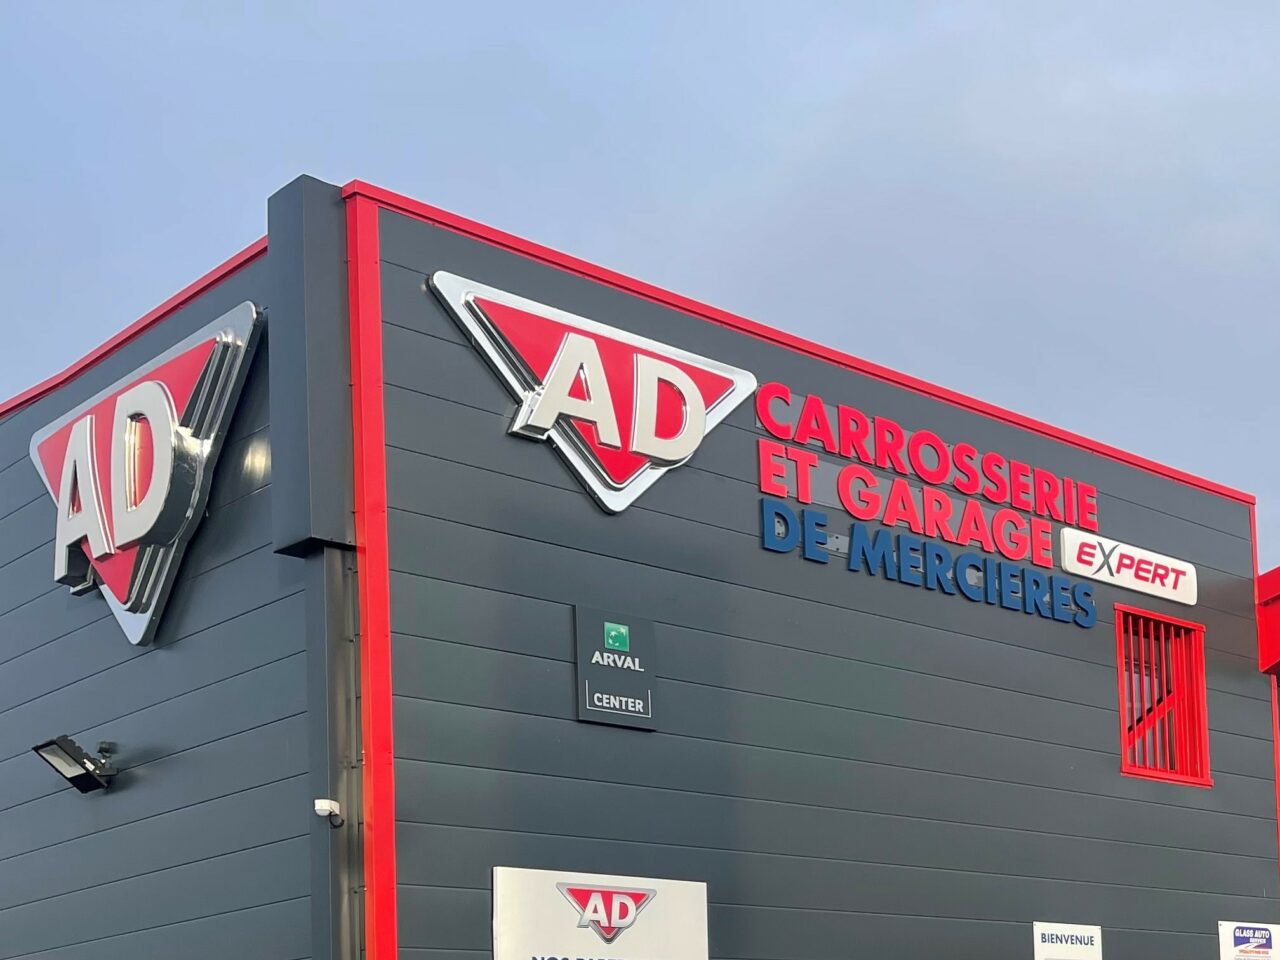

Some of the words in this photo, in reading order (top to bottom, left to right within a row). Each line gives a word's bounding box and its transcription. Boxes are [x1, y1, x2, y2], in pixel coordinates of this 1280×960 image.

[522, 331, 708, 466] AD
[53, 379, 190, 590] AD
[756, 382, 1098, 531] CARROSSERIE
[758, 439, 818, 504] ET
[837, 464, 1053, 569] GARAGE
[761, 498, 831, 564] DE
[848, 523, 1098, 628] MERCIERES
[591, 650, 645, 671] ARVAL
[593, 693, 644, 712] CENTER
[578, 892, 637, 928] AD
[1041, 933, 1095, 946] BIENVENUE
[1235, 928, 1254, 937] GLASS
[1254, 930, 1270, 939] AUTO
